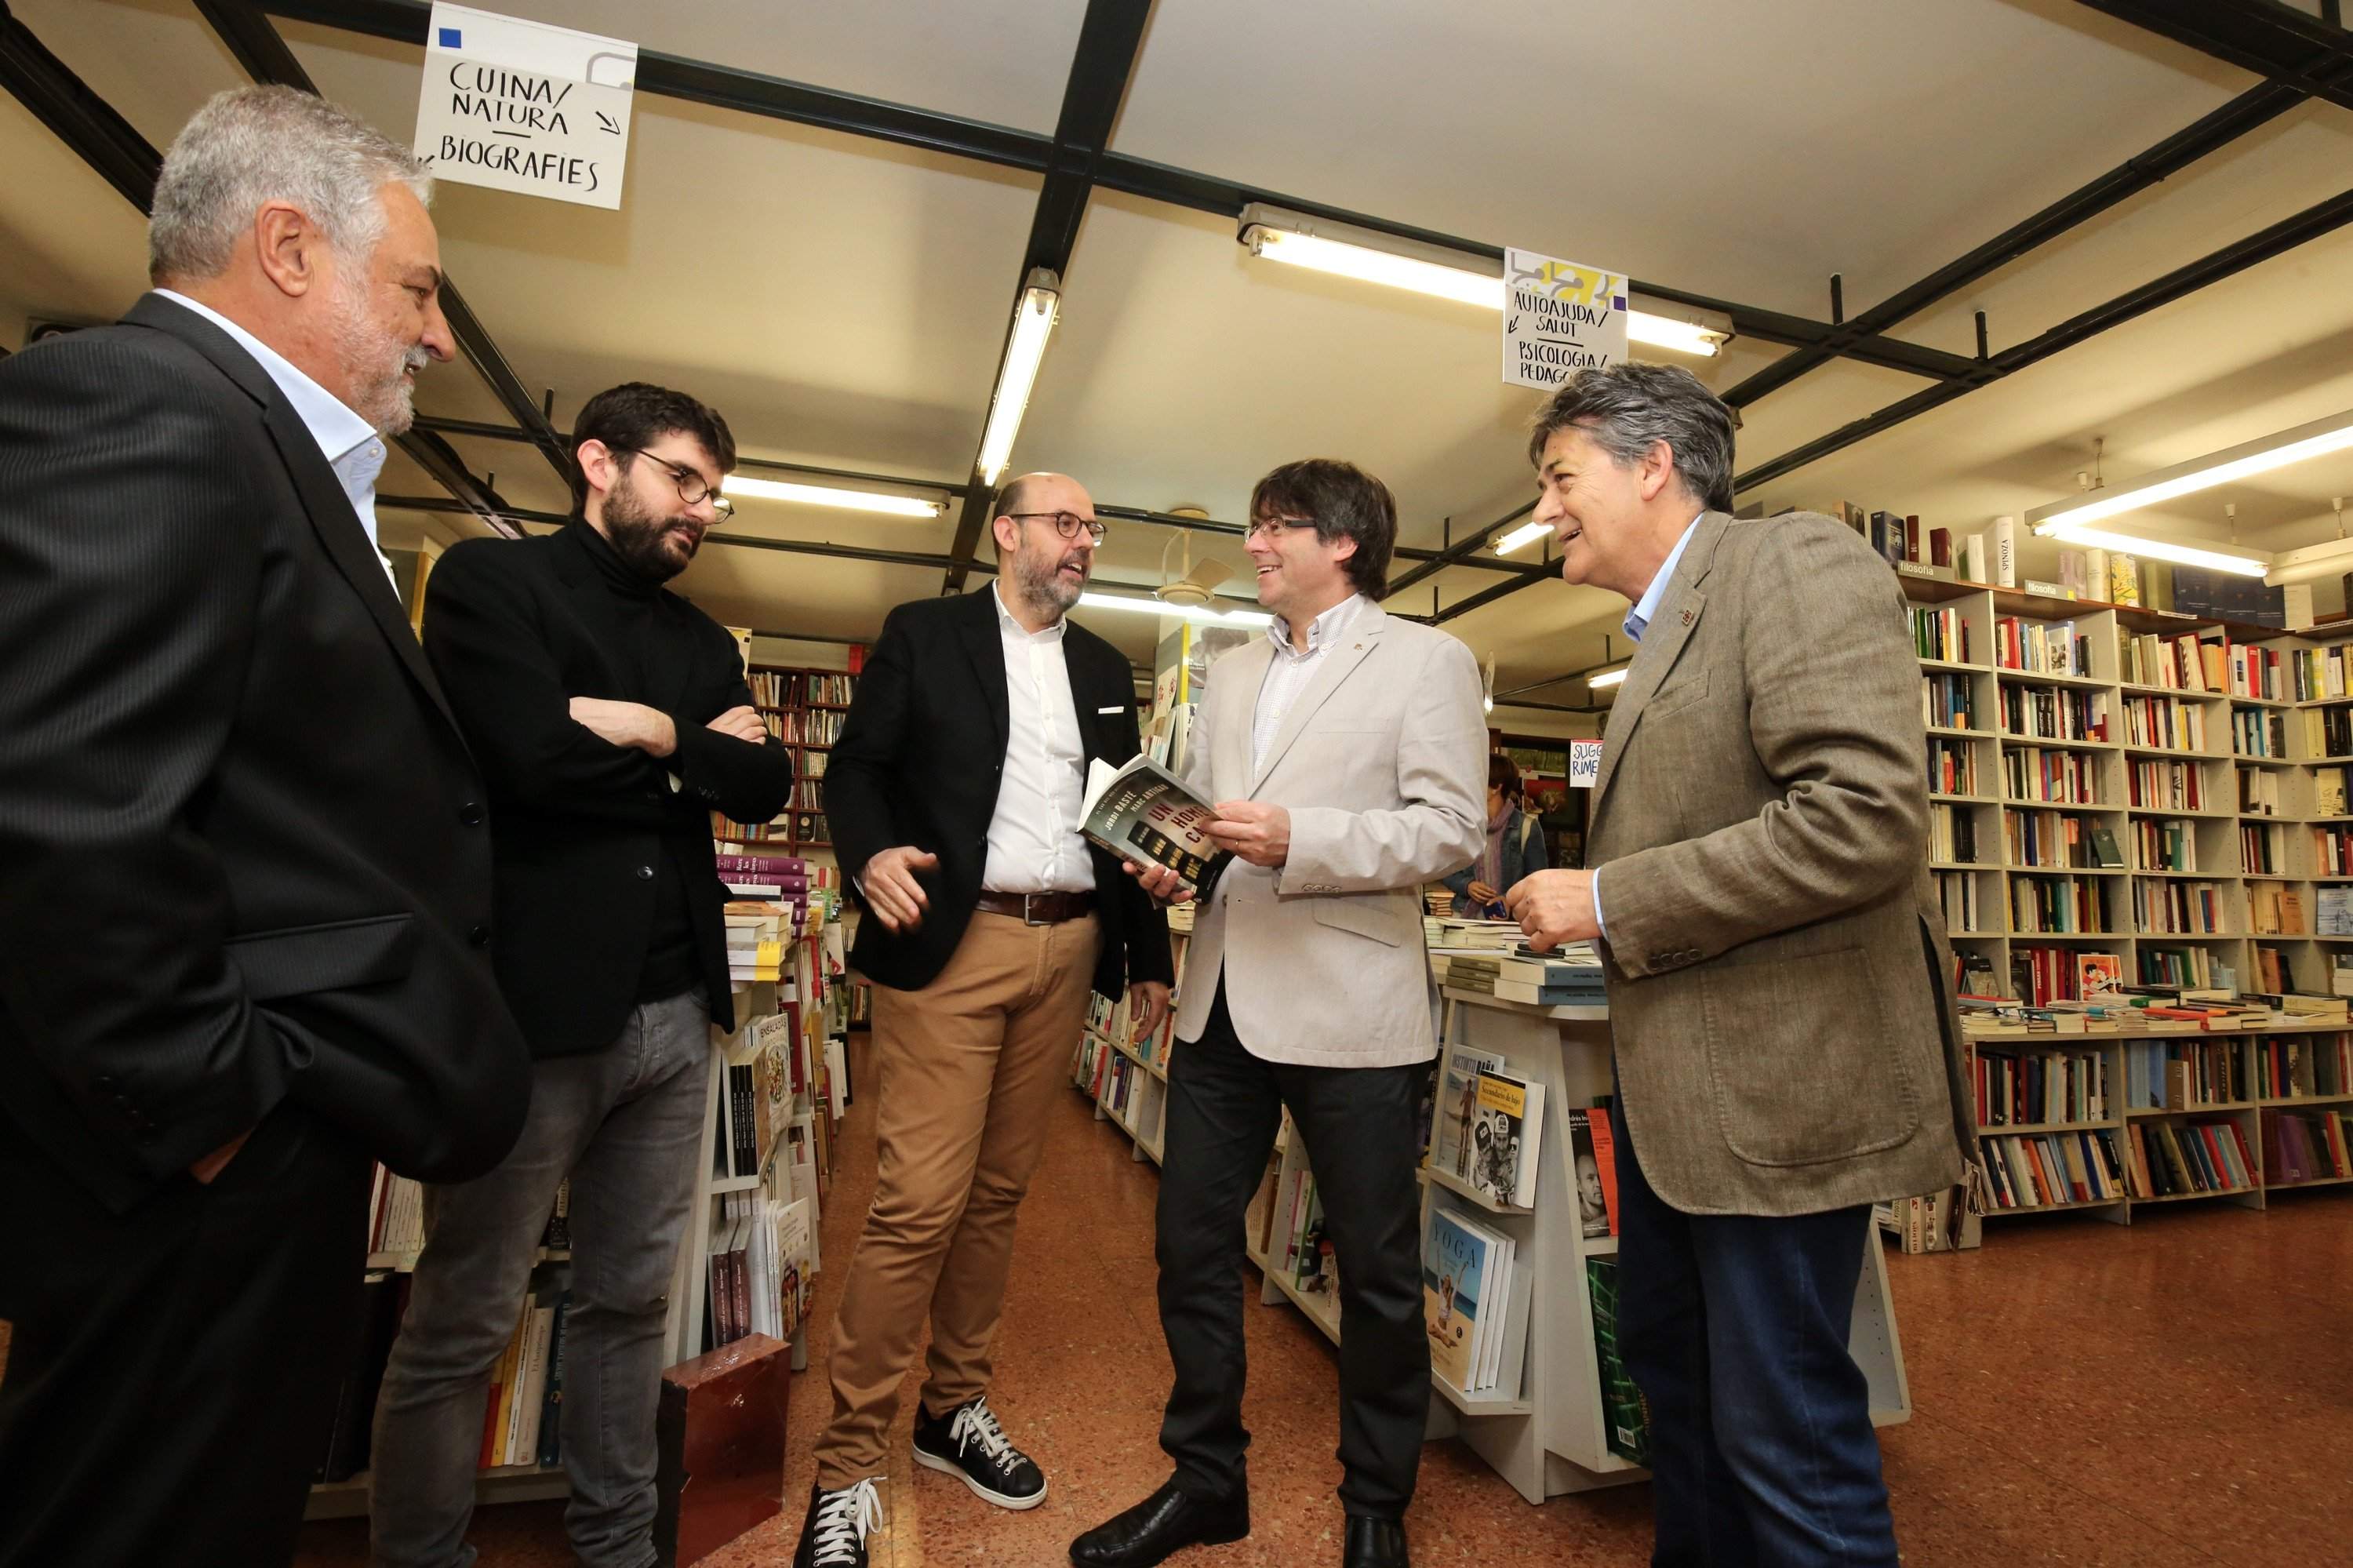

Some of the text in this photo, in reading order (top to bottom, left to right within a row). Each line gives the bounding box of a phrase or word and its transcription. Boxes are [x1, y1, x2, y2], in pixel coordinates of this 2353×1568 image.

[449, 62, 573, 109] CUINA/
[453, 93, 568, 135] NATURA
[441, 135, 600, 191] BIOGRAFIES
[1514, 291, 1609, 328] AUTOAJUDA/
[1536, 315, 1579, 337] SALUT
[1520, 362, 1573, 384] PEDAGO
[2001, 538, 2009, 571] SPINOZA
[1900, 561, 1934, 576] filosofia
[2028, 583, 2057, 595] filosofia
[1573, 744, 1602, 759] SUGG
[1573, 759, 1598, 777] RIME
[1104, 809, 1120, 831] JORDI
[1114, 790, 1137, 813] BASTÉ
[1130, 795, 1147, 813] MARC
[1148, 802, 1174, 822] UN
[1170, 806, 1209, 828] HOME
[1185, 821, 1209, 843] CA
[1433, 1222, 1475, 1268] YOGA
